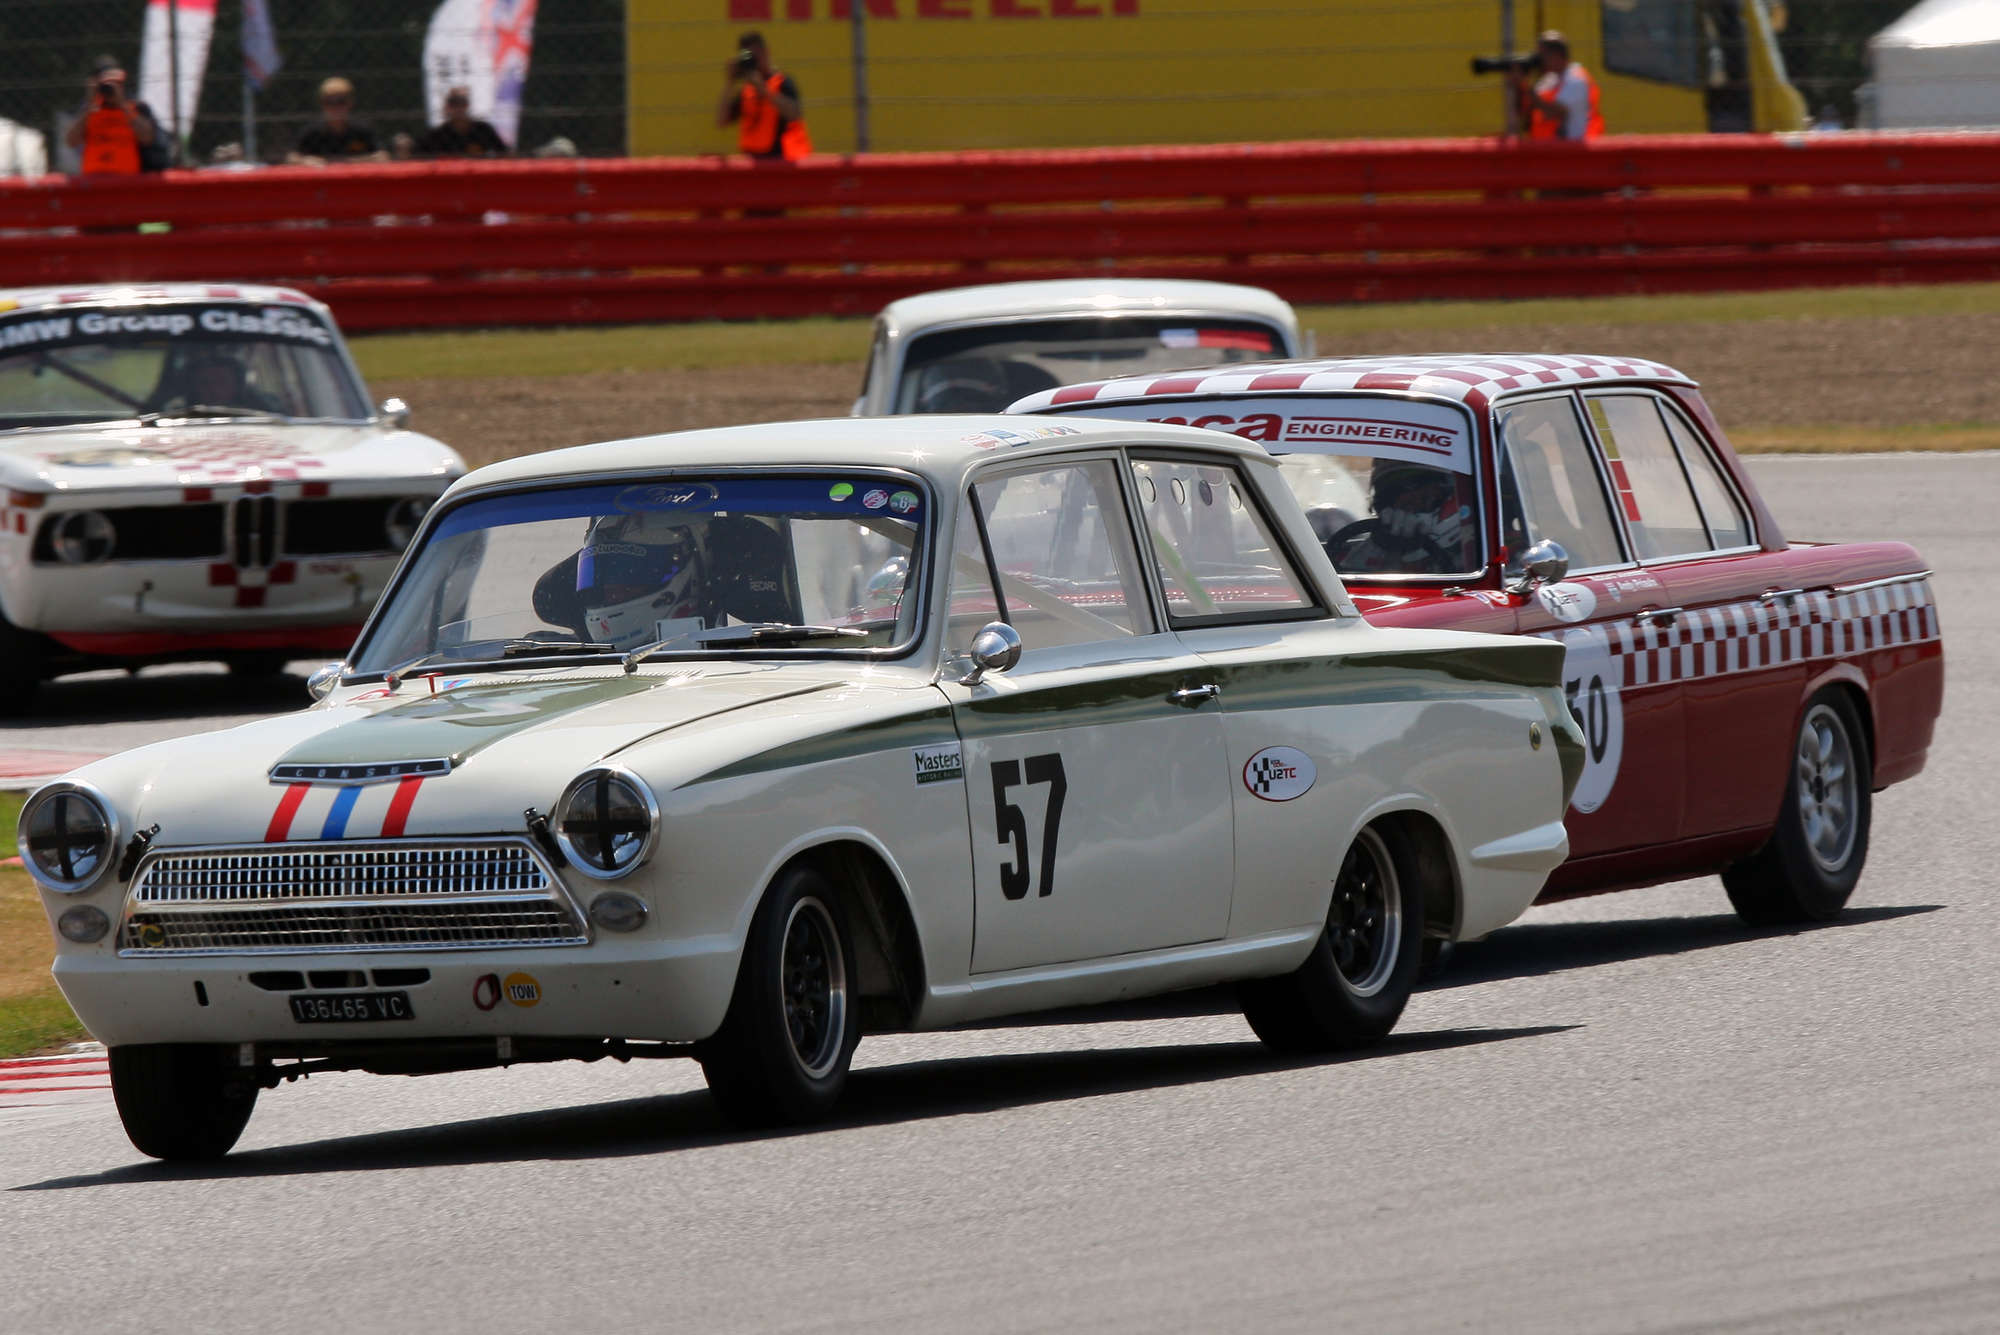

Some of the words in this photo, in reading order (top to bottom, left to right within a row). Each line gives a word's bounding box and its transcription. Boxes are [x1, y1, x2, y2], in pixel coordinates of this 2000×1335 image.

[0, 318, 71, 347] MW
[77, 313, 193, 335] Group
[202, 310, 331, 345] Classic
[1286, 423, 1453, 448] ENGINEERING
[295, 764, 423, 778] CONSUL
[914, 752, 960, 771] Masters
[1268, 767, 1297, 780] U2TC
[991, 752, 1068, 900] 57
[510, 984, 536, 1000] TOW
[296, 998, 369, 1020] 136465
[377, 996, 404, 1018] VC
